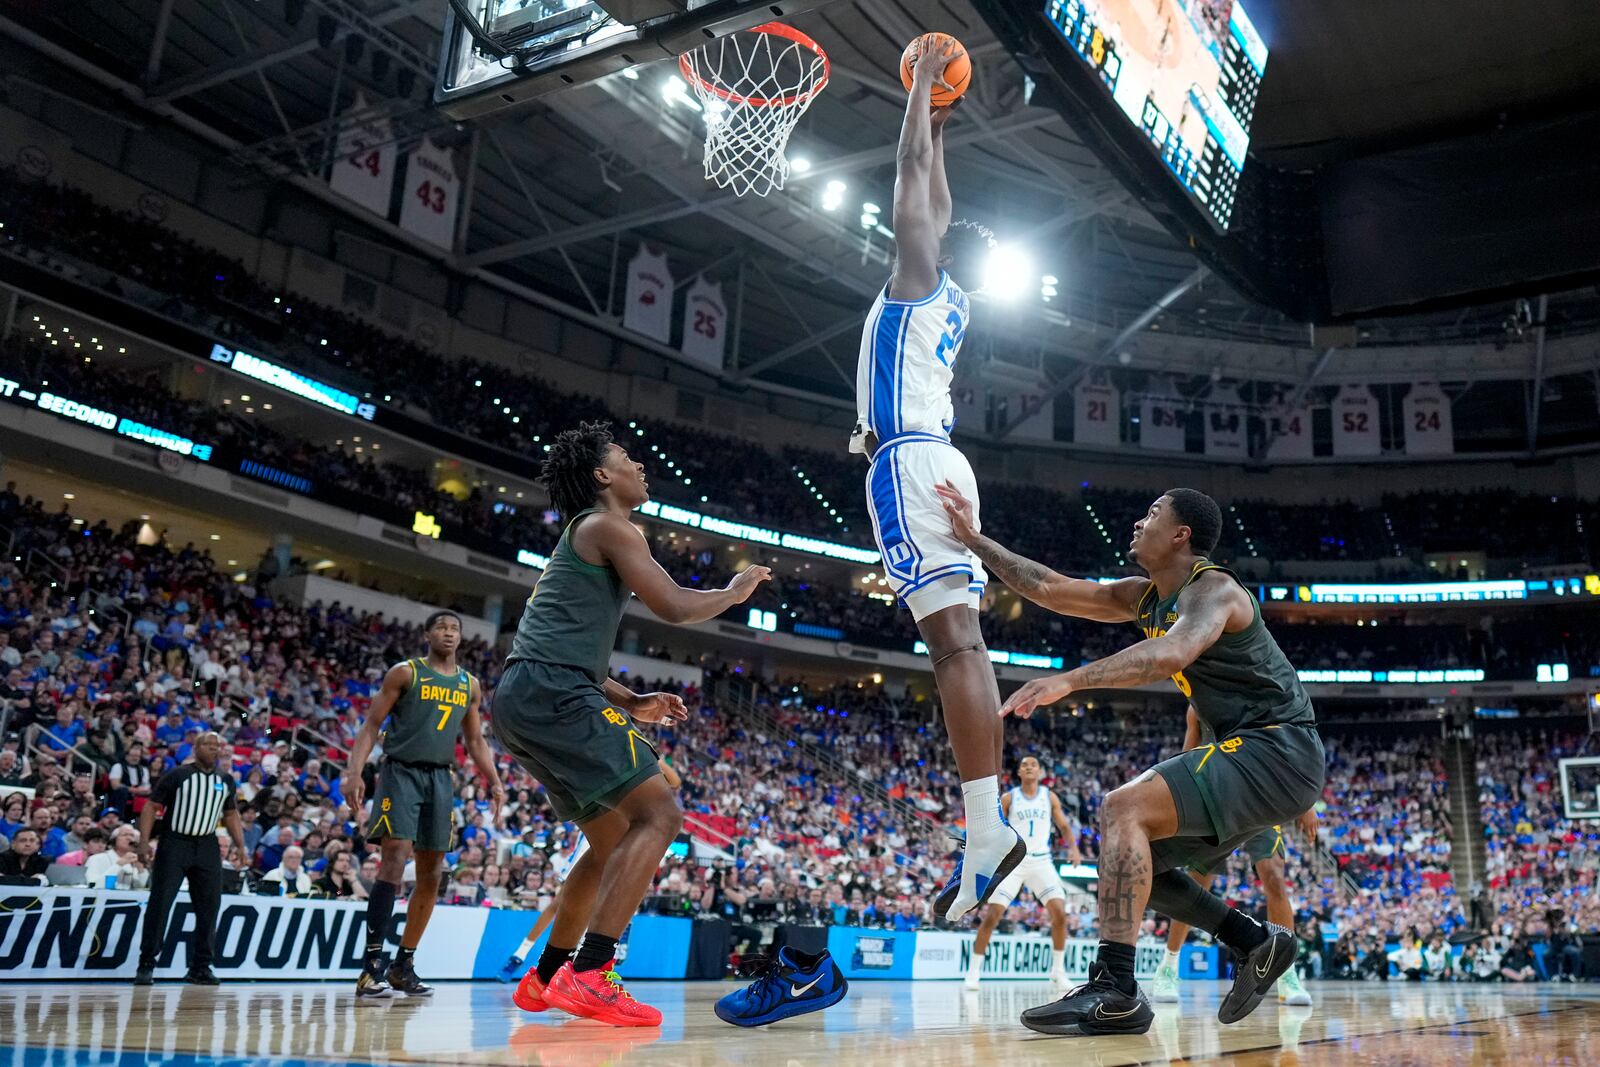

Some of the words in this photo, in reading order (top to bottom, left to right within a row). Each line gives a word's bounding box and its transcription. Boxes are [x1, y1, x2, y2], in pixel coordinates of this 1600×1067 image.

[416, 180, 446, 214] 43
[693, 309, 716, 340] 25
[38, 392, 118, 430] SECOND
[1088, 401, 1107, 422] 21
[1343, 412, 1369, 433] 52
[1415, 411, 1441, 433] 24
[700, 515, 781, 546] BASKETBALL
[420, 684, 468, 708] BAYLOR
[436, 704, 453, 731] 7
[1016, 808, 1048, 821] DUKE
[1028, 820, 1034, 838] 1
[960, 939, 1010, 973] NRTH
[1014, 941, 1076, 974] CARONA
